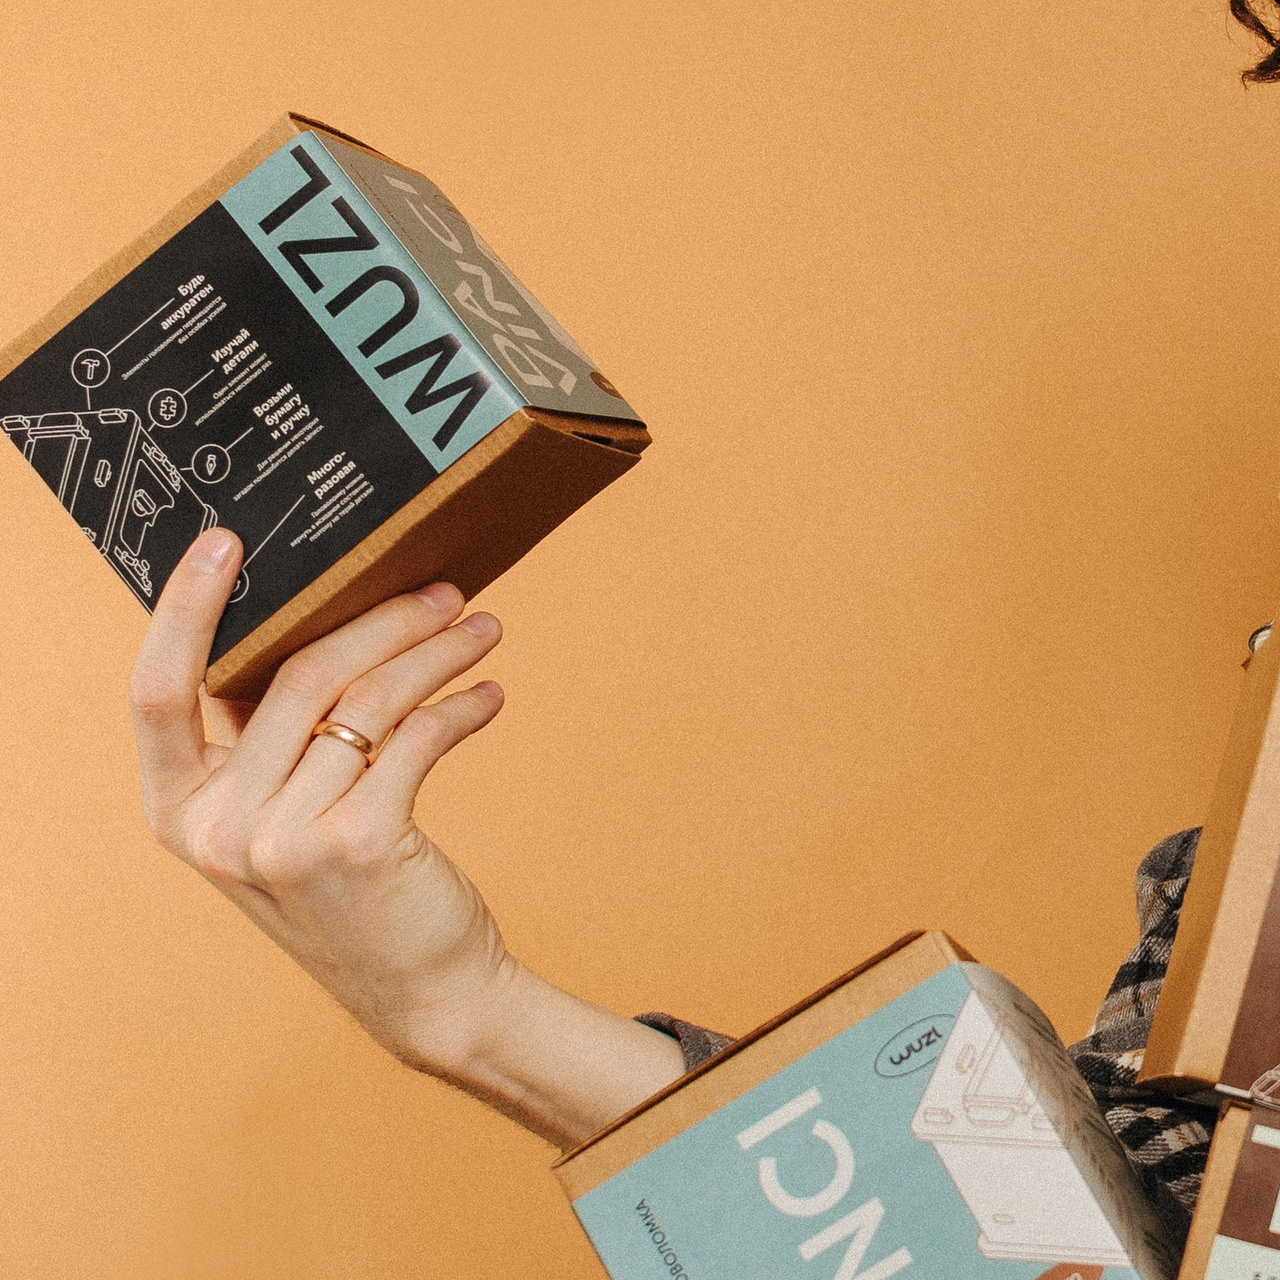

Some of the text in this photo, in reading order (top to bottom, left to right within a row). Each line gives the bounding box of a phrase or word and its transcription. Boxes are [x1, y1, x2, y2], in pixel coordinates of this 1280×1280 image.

[177, 270, 207, 298] Будь
[258, 145, 490, 452] WUZL
[383, 174, 577, 396] VINCI
[159, 282, 216, 332] аккуратен
[210, 327, 252, 365] Изучай
[454, 280, 553, 388] DA
[220, 339, 260, 375] детали
[252, 380, 294, 418] Возьми
[263, 391, 304, 429] бумагу
[270, 404, 313, 440] и ручку
[306, 447, 348, 484] Много-
[313, 459, 358, 500] разовая
